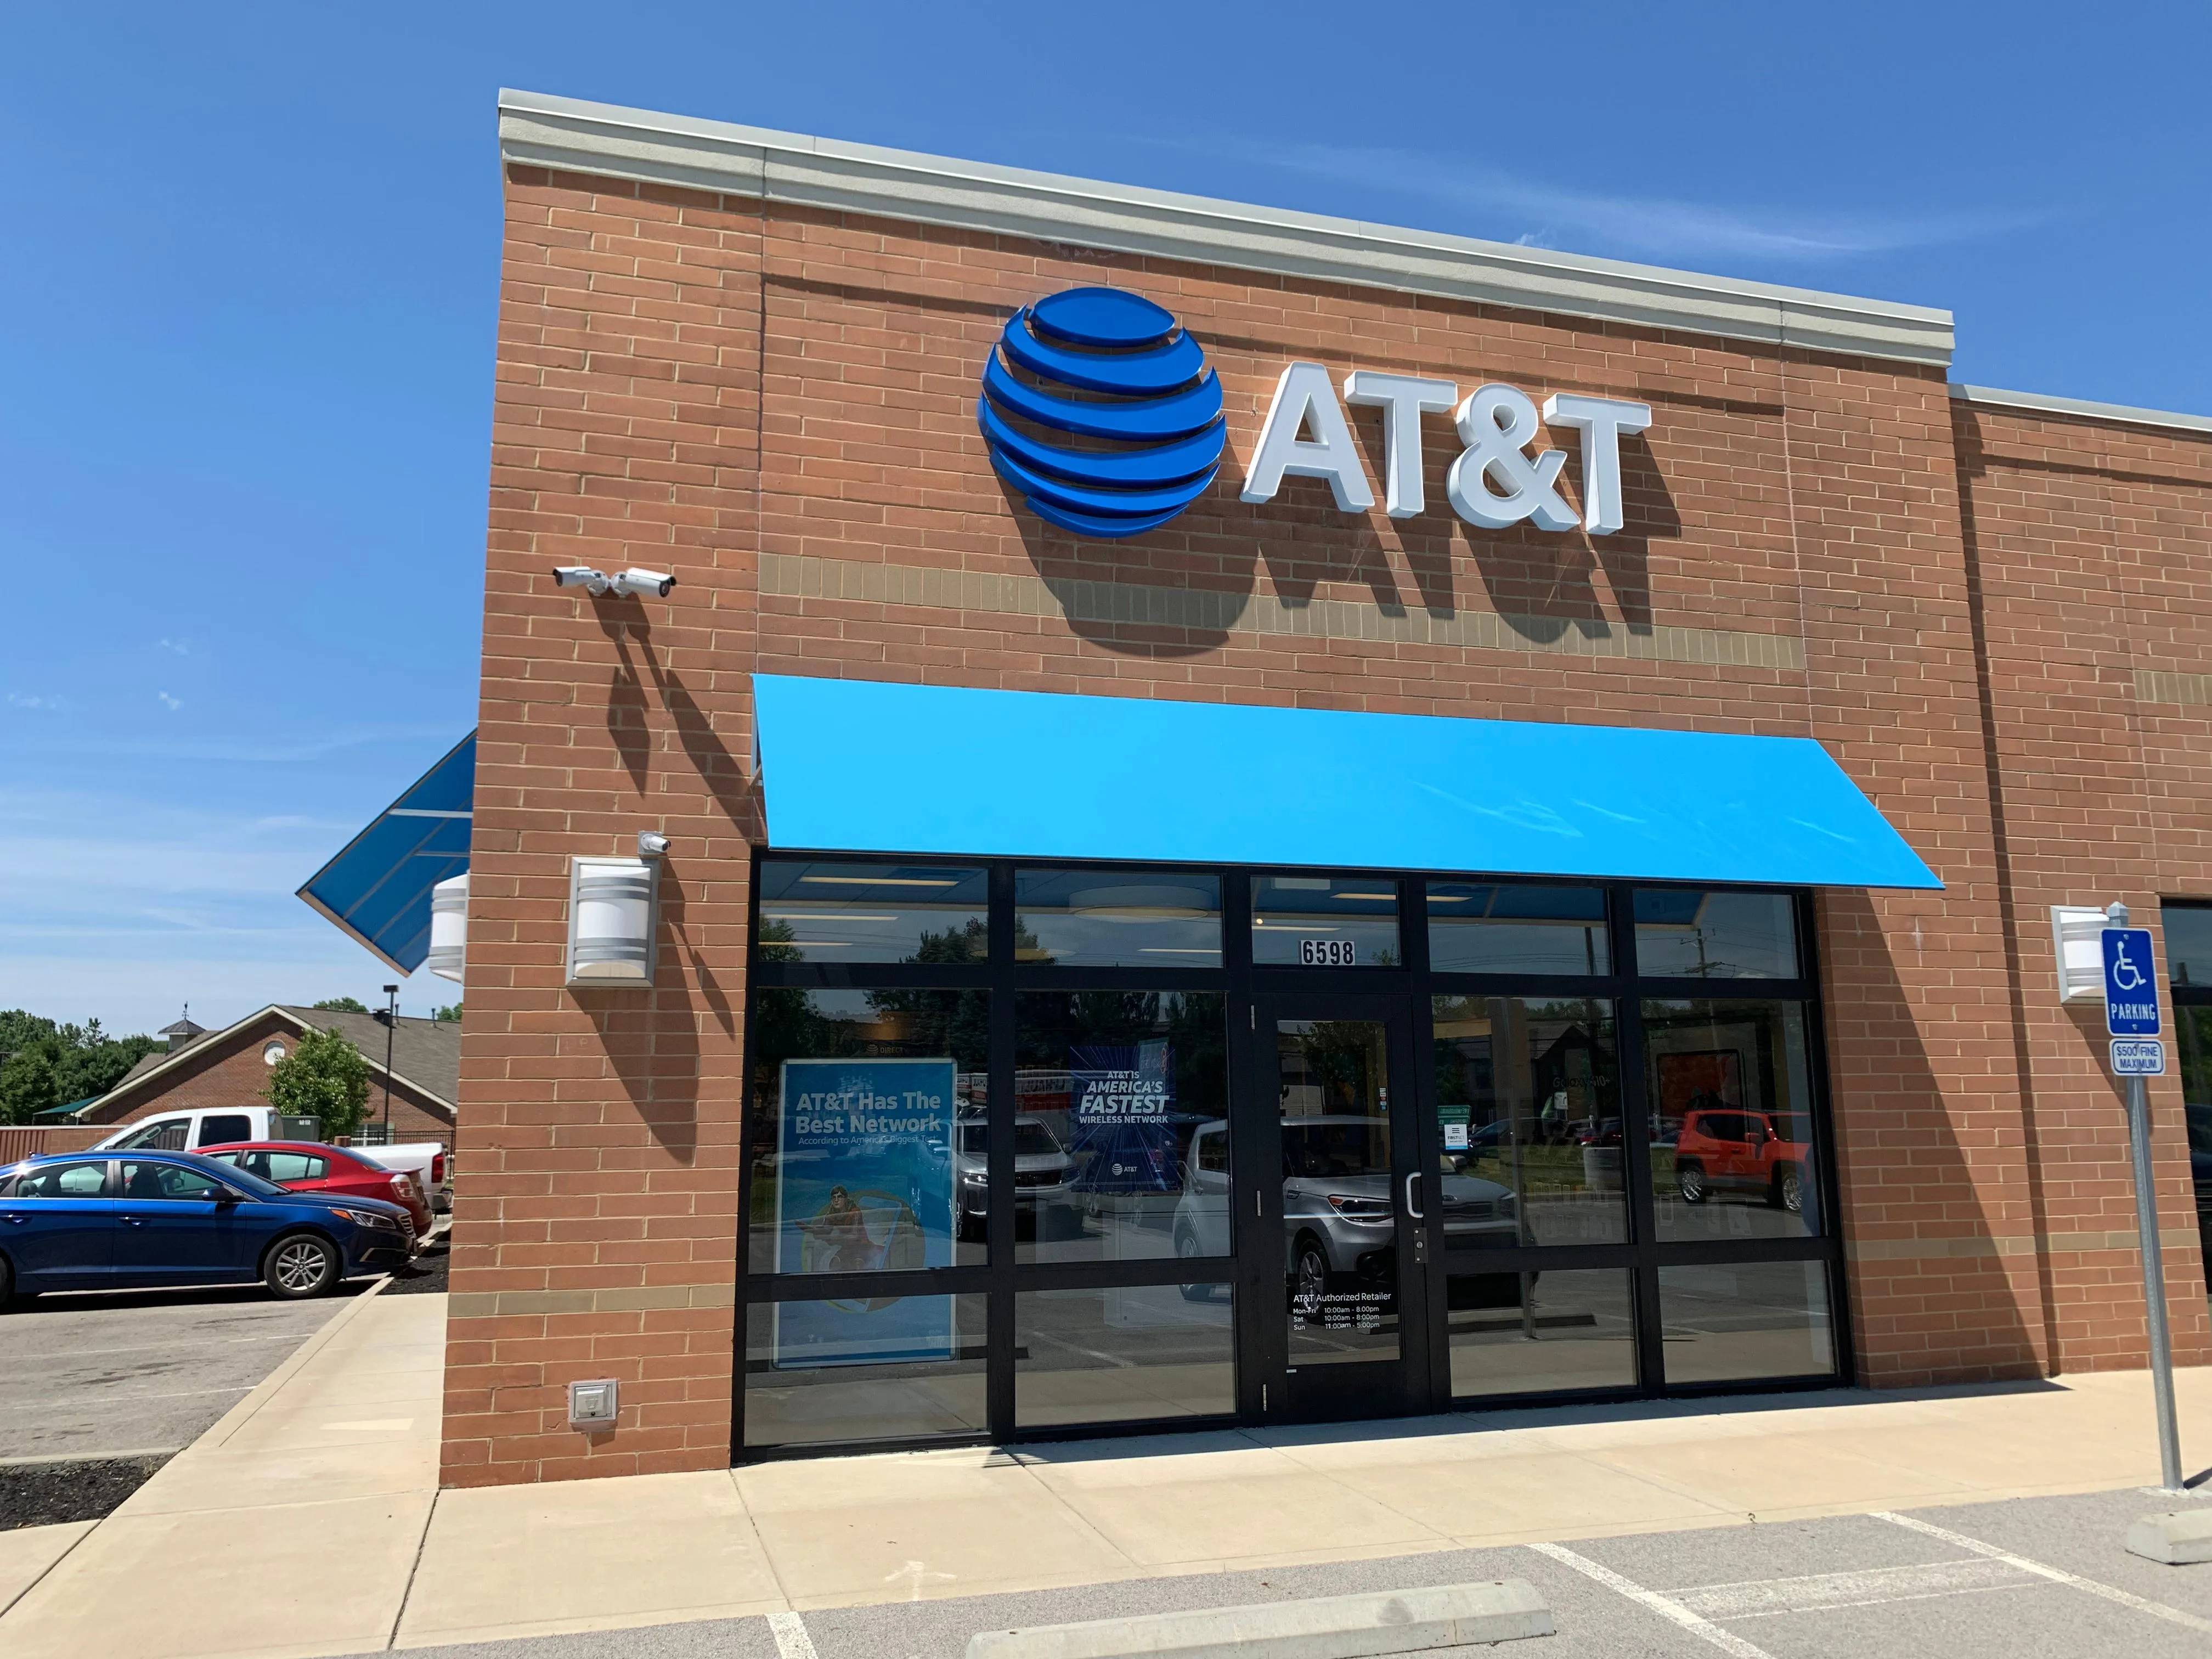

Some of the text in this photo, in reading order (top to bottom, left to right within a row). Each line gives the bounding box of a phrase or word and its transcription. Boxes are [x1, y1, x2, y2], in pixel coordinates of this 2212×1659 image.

[1239, 360, 1652, 536] AT&T
[1303, 940, 1353, 964] 6598
[2111, 1003, 2156, 1020] PARKING
[2117, 1046, 2158, 1057] $500 FINE
[2120, 1059, 2157, 1069] MAXIMUM
[1086, 1081, 1163, 1093] AMERICA'S
[796, 1091, 941, 1111] AT&T Has The
[1079, 1095, 1170, 1114] FASTEST
[795, 1113, 941, 1134] Best Network
[1124, 1115, 1169, 1124] NETWORK
[798, 1137, 838, 1146] According
[850, 1136, 890, 1144] America's
[890, 1135, 919, 1144] Biggest
[1294, 1292, 1391, 1302] AT&T Authorized Retailer
